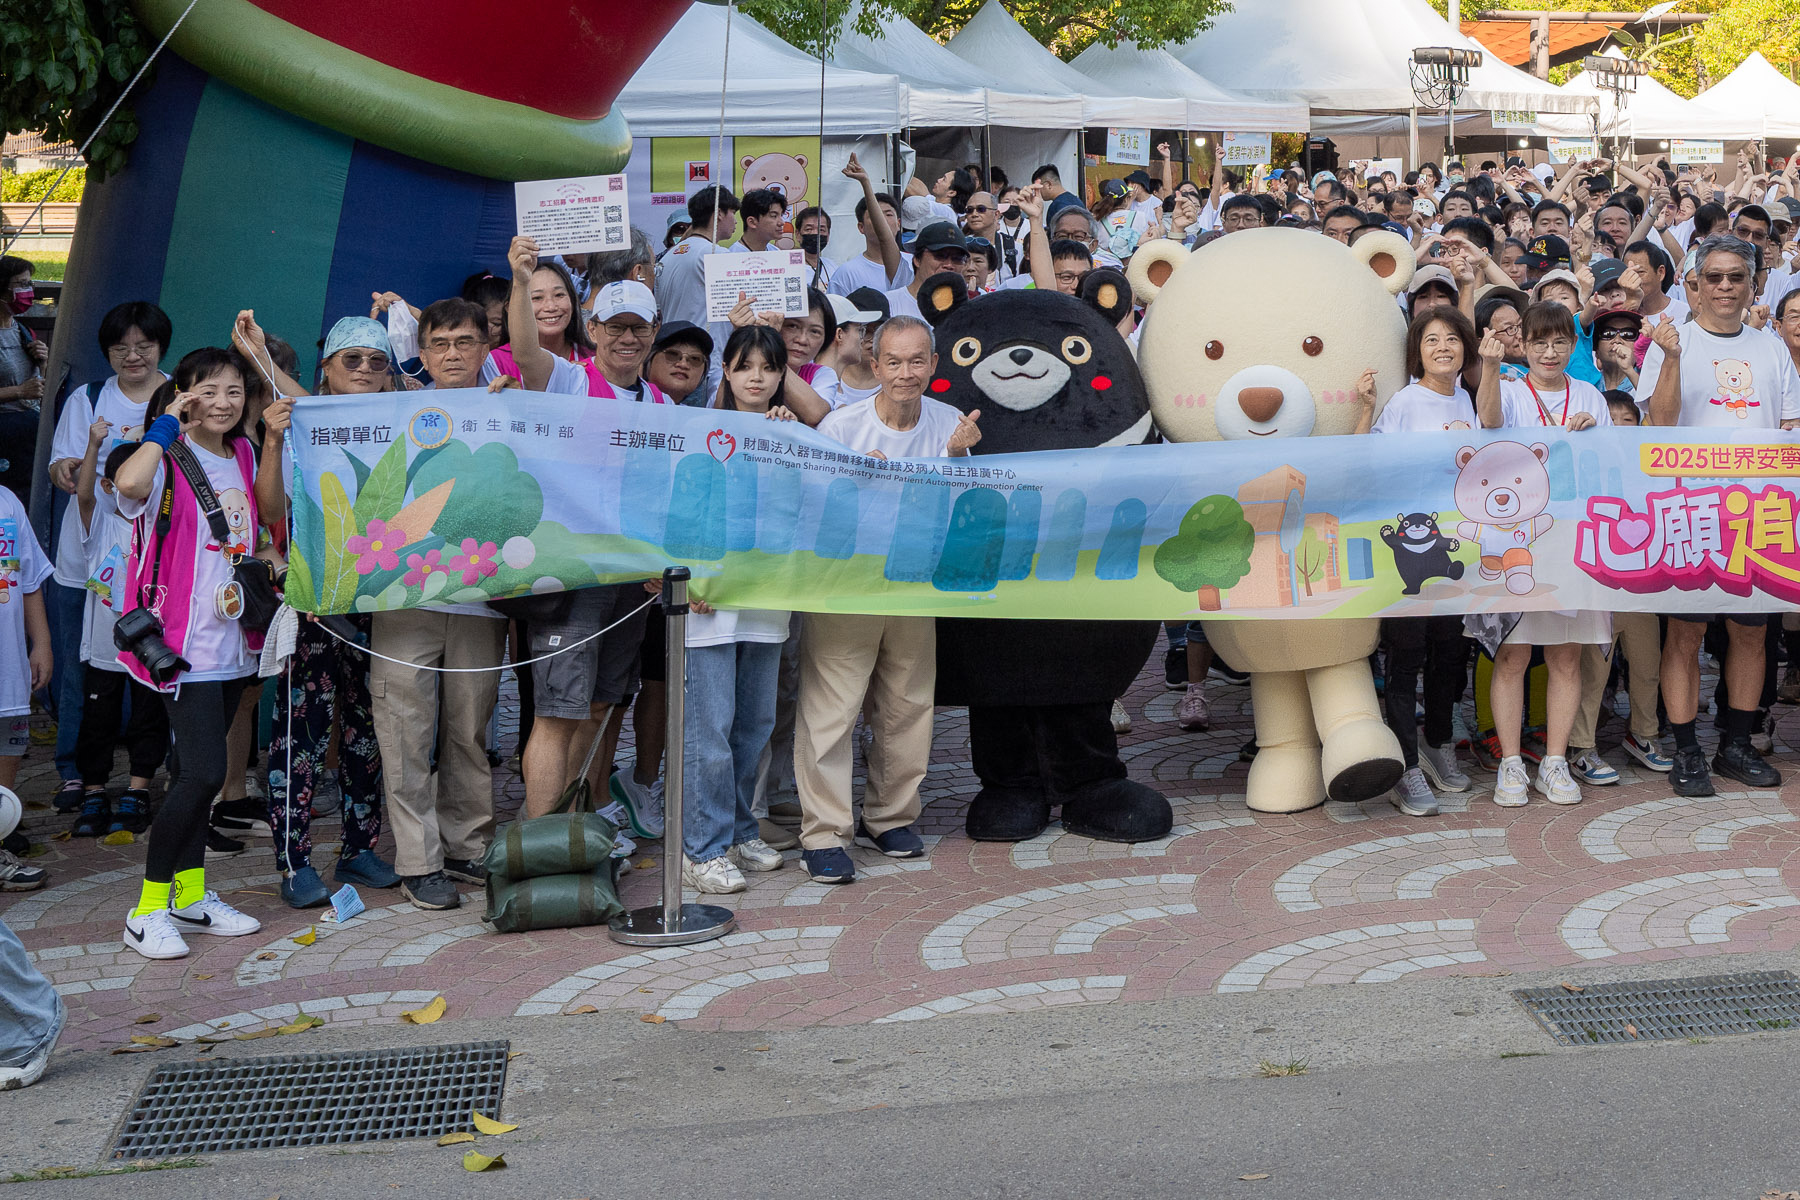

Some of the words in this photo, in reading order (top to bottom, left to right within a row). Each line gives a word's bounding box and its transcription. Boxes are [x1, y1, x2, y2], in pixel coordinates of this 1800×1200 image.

[694, 166, 705, 177] 15
[310, 425, 392, 446] 指導單位
[461, 418, 575, 439] 衛生福利部
[609, 429, 686, 453] 主辦單位
[743, 437, 1017, 480] 財團法人器官捐贈移植登錄及病人自主推廣中心
[742, 453, 773, 464] Taiwan
[774, 457, 801, 469] Organ
[803, 461, 836, 474] Sharing
[838, 464, 874, 479] Registry
[894, 474, 924, 485] Patient
[926, 478, 969, 489] Autonomy
[971, 481, 1015, 491] Promotion
[1016, 483, 1044, 492] Center
[162, 488, 172, 515] Nikon
